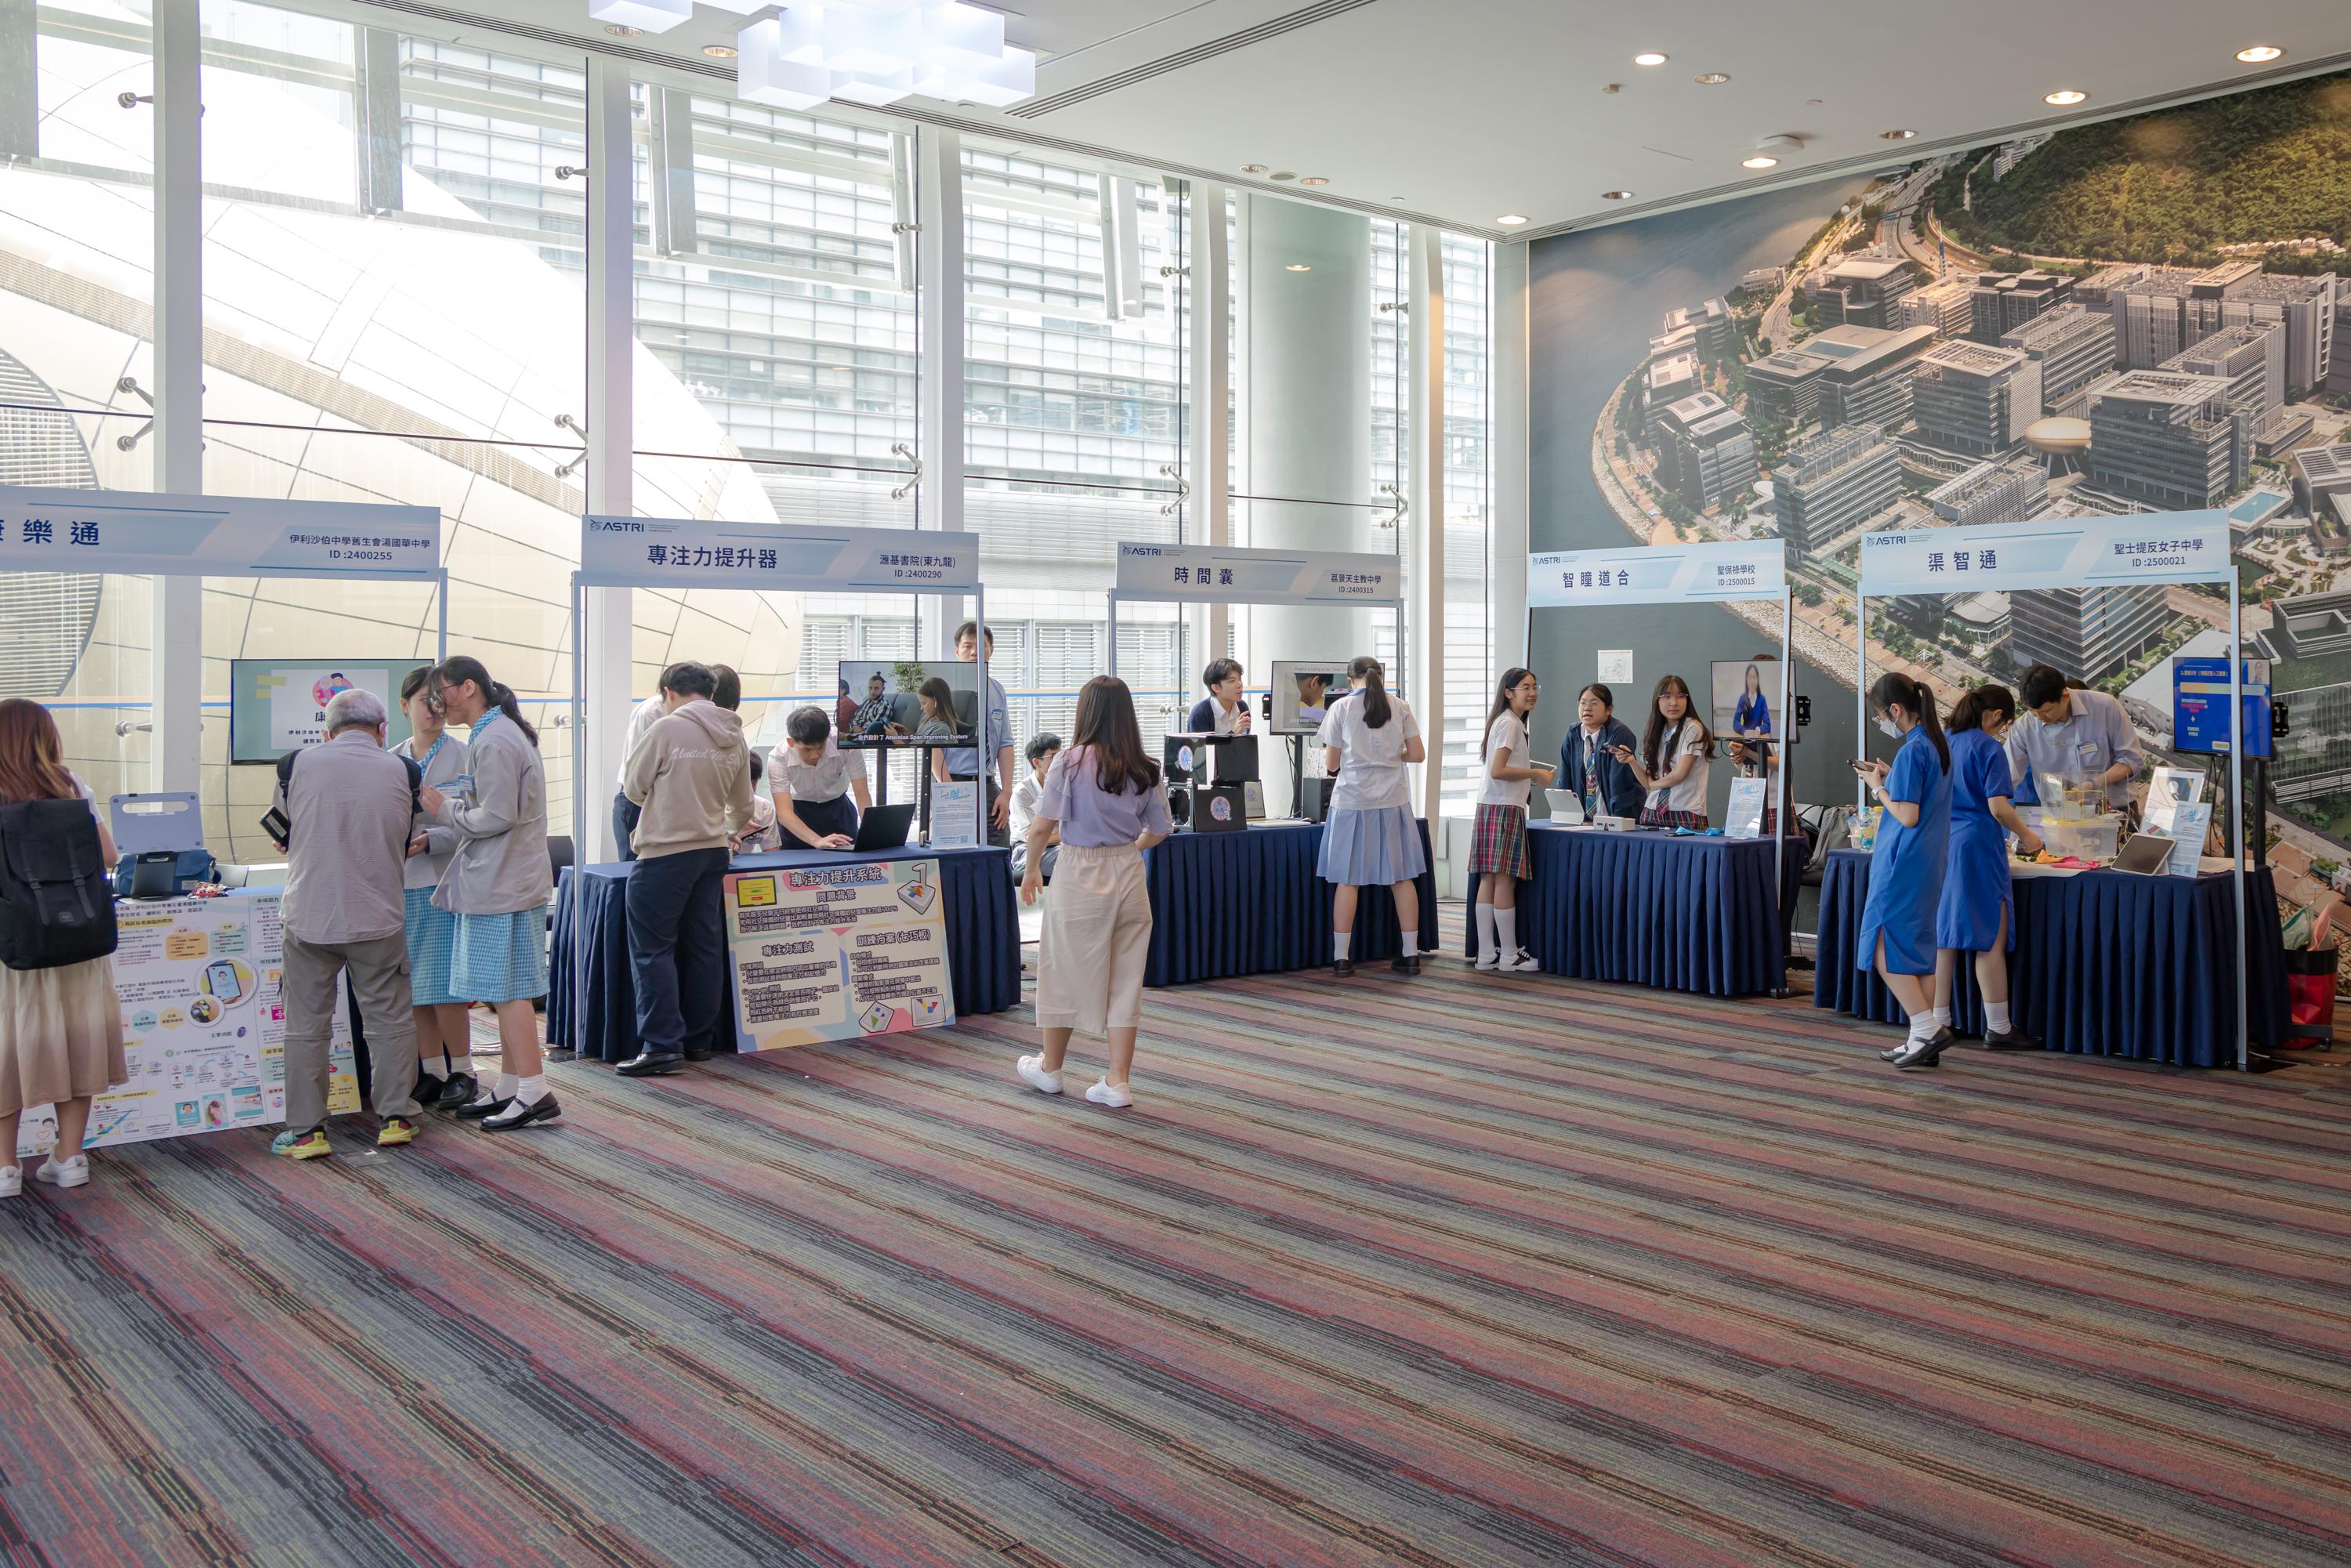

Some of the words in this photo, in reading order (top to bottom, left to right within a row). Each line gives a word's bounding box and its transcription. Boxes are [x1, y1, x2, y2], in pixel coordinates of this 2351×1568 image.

[0, 519, 100, 546] 樂通
[602, 523, 644, 533] ASTRI
[289, 534, 430, 549] 伊利沙伯中學舊生會湯國華中學
[1875, 535, 1907, 546] ASTRI
[2114, 538, 2204, 556] 聖士提反女子中學
[329, 550, 341, 559] ID
[647, 544, 777, 570] 專注力提升器
[1131, 547, 1161, 557] ASTRI
[1538, 556, 1561, 565] ASTRI
[1928, 549, 1998, 572] 渠智通
[2132, 559, 2142, 567] ID
[894, 569, 904, 578] ID
[1174, 566, 1233, 585] 時間囊
[1716, 563, 1755, 576] 聖保祿學校
[1330, 573, 1382, 585] 荔景天主教中學
[1563, 569, 1629, 588] 智瞳道合
[1718, 578, 1726, 587] ID
[1339, 585, 1346, 594] ID
[790, 867, 882, 887] 專注力提升系統
[816, 889, 857, 903] 問題背景
[762, 940, 814, 957] 專注力測試
